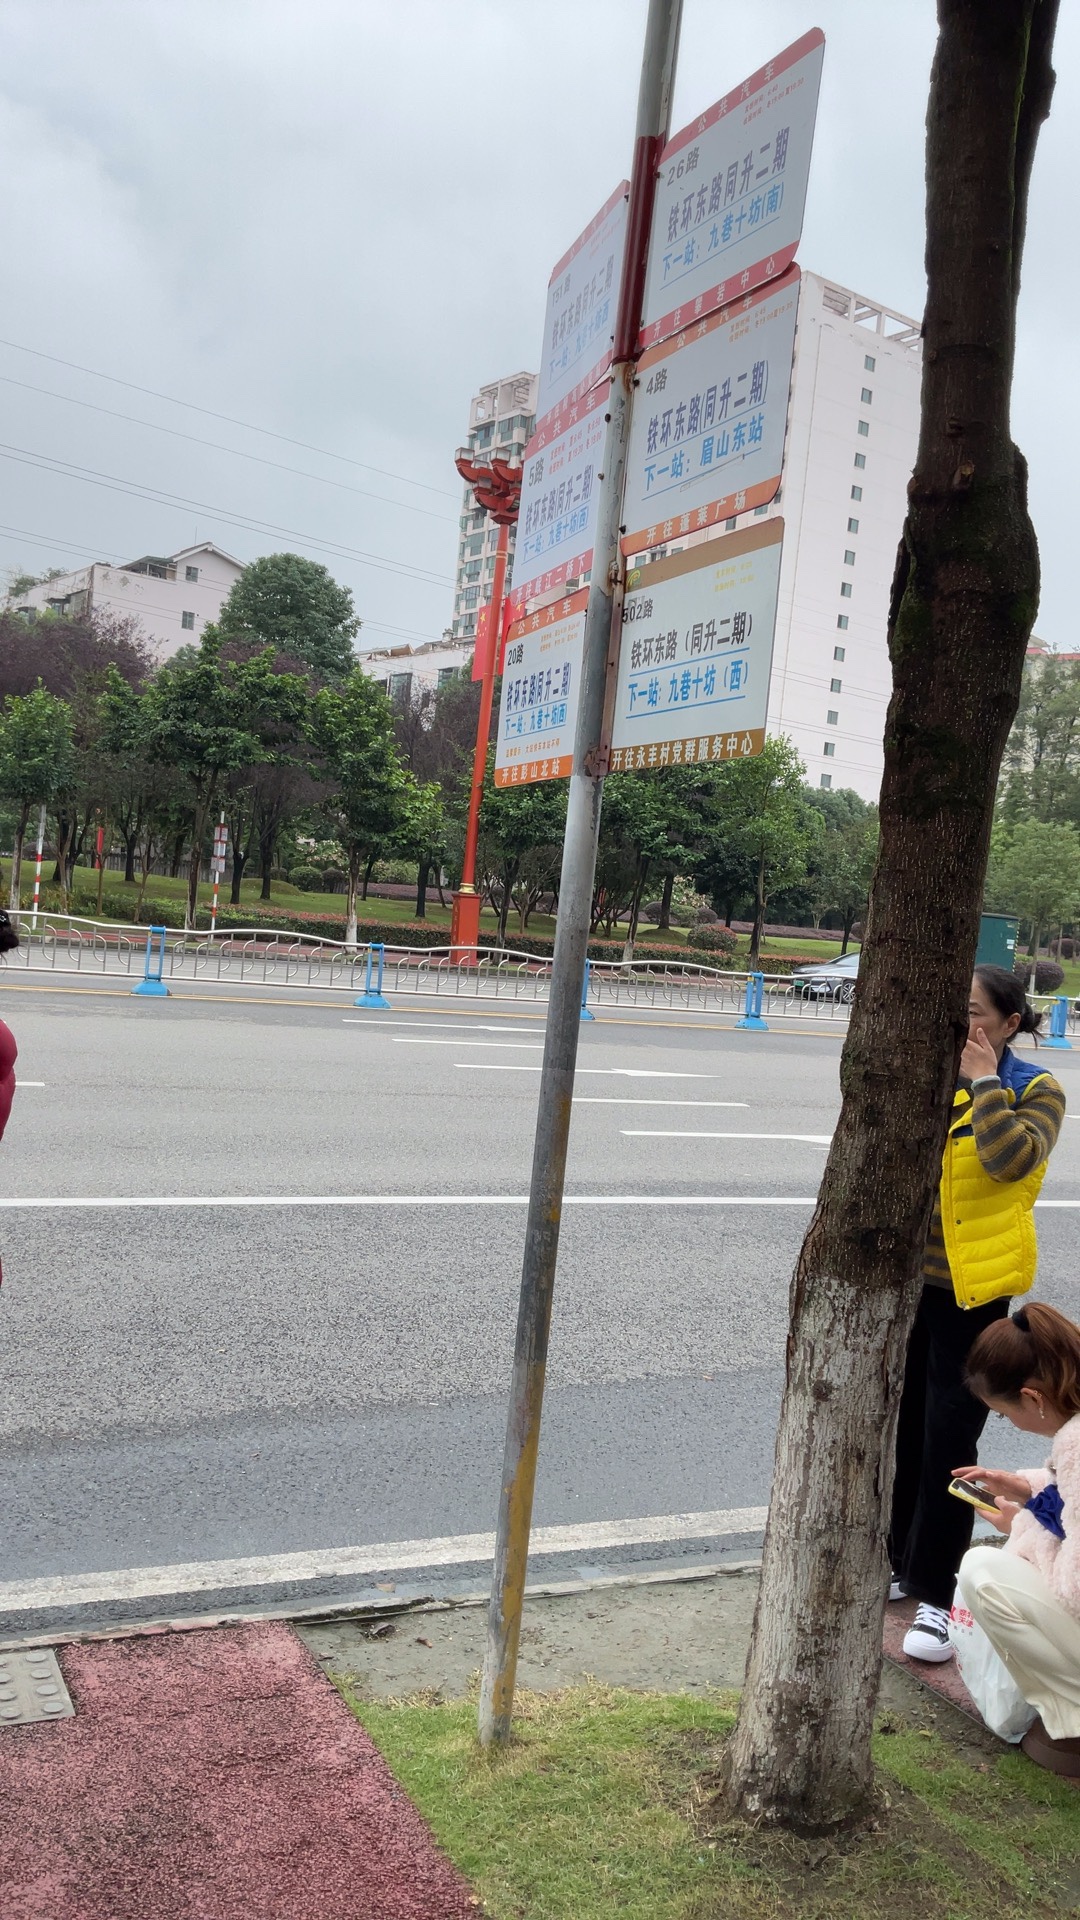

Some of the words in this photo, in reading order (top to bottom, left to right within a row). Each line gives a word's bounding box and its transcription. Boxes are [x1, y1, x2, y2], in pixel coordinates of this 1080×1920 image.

[698, 62, 774, 132] 公共汽车
[667, 146, 700, 187] 26路
[667, 126, 790, 243] 铁环东路同升二期
[676, 290, 753, 349] 公共汽车
[646, 367, 668, 395] 4路
[537, 393, 595, 448] 公共汽车
[528, 456, 545, 487] 5路
[646, 490, 746, 545] 开往蓬莱广场
[518, 599, 572, 635] 公共汽车
[622, 598, 654, 623] 502路
[507, 643, 524, 667] 20路
[612, 731, 753, 770] 开往永丰村党群服务中心
[502, 758, 560, 783] 开往彭山北站
